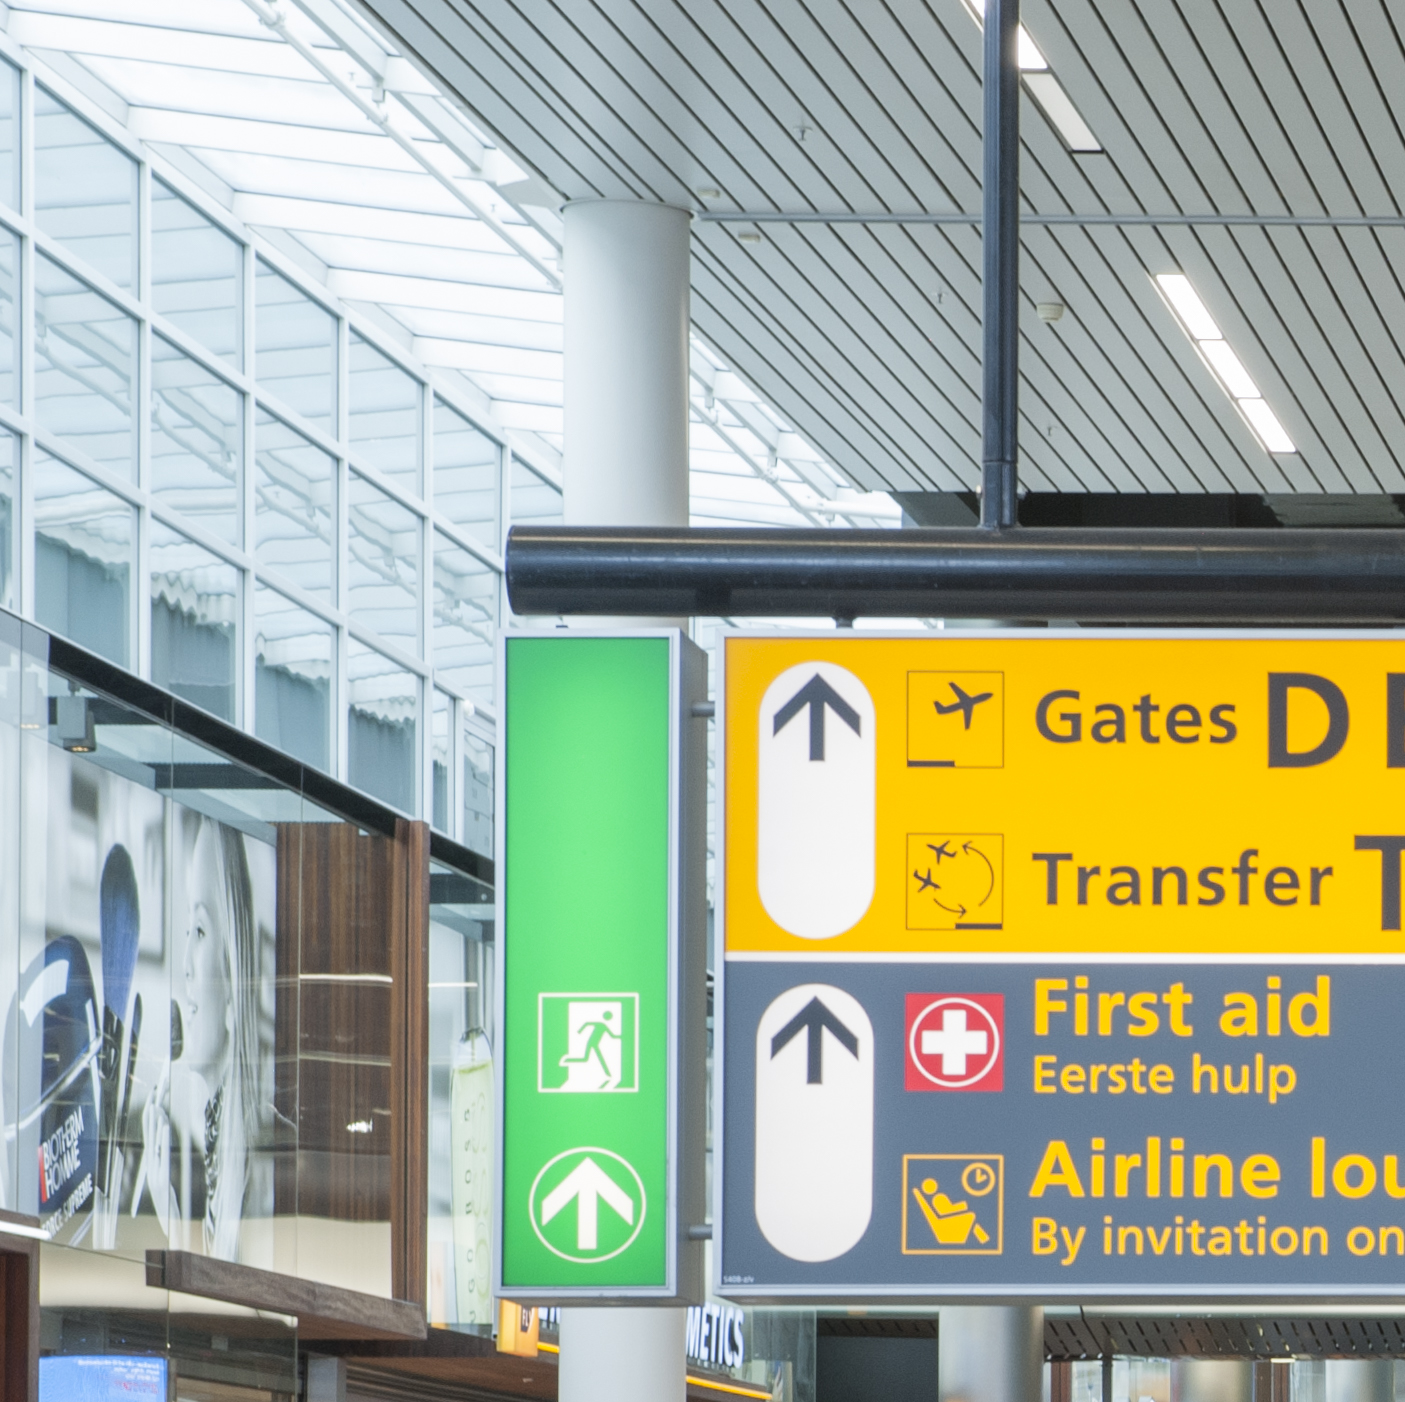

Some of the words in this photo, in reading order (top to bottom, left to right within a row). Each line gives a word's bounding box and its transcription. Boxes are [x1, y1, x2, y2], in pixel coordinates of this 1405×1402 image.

[1035, 689, 1238, 744] Gates
[1032, 848, 1333, 906] Transfer
[1034, 976, 1193, 1037] First
[1218, 975, 1331, 1037] aid
[1034, 1055, 1183, 1095] Eerste
[1192, 1053, 1297, 1103] hulp
[43, 1105, 84, 1170] BIOTHERM
[45, 1140, 81, 1199] HOMME
[1028, 1136, 1281, 1199] Airline
[64, 1172, 93, 1222] SUPREME
[1032, 1218, 1087, 1266] By
[1103, 1215, 1329, 1256] invitation
